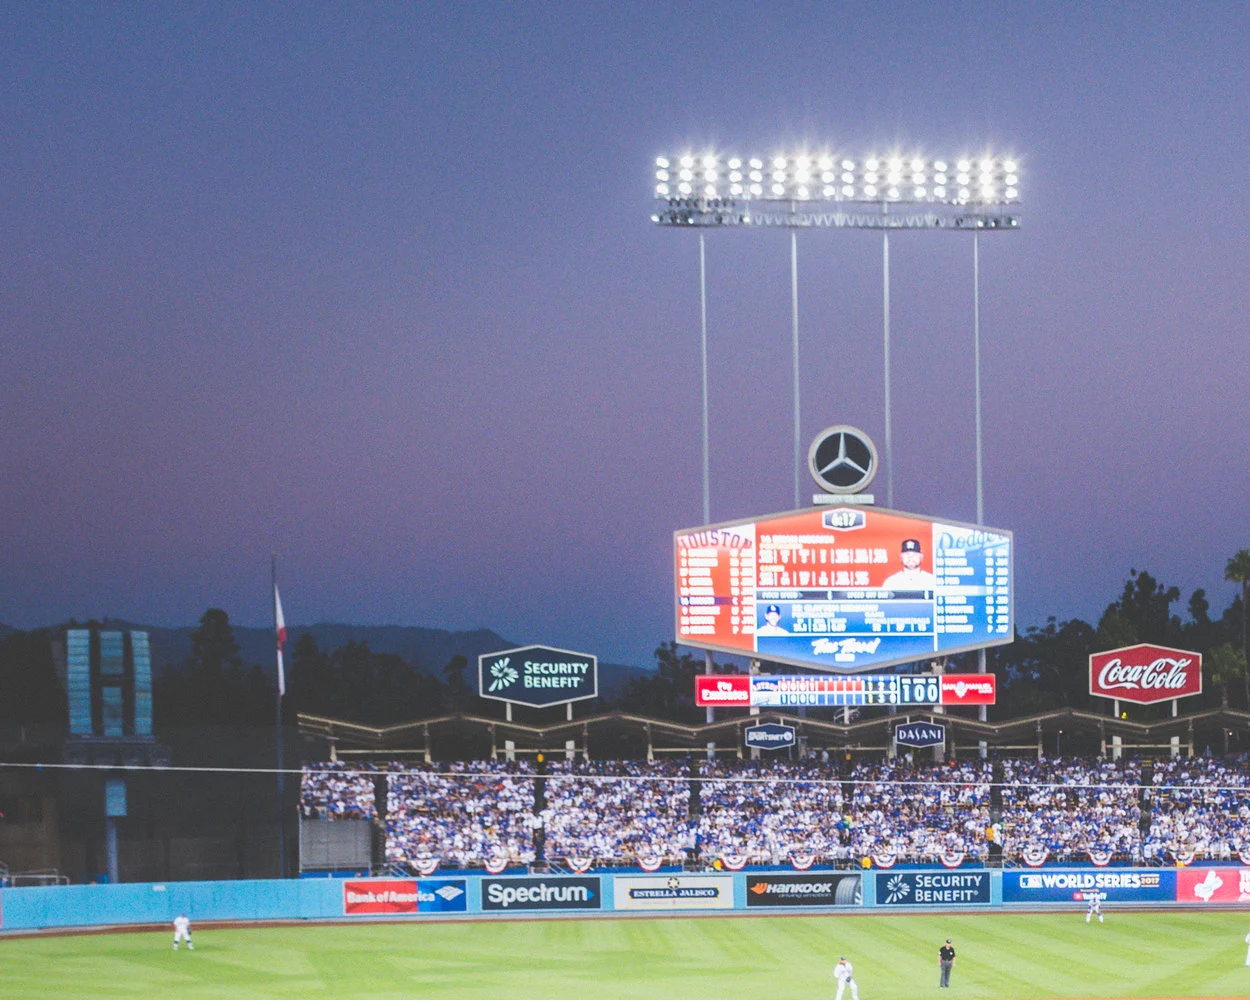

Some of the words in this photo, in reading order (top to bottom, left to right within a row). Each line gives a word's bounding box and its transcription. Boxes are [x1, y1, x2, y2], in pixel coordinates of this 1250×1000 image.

[524, 661, 589, 675] SECURITY
[1098, 657, 1192, 690] Coca-Cola
[899, 729, 941, 742] DASANI
[915, 874, 982, 887] SECURITY
[1042, 874, 1096, 889] WORLD
[1095, 873, 1141, 888] SERIES
[1141, 877, 1160, 885] 2017
[488, 883, 588, 907] Spectrum
[633, 889, 678, 898] ESTRELLA
[679, 888, 715, 897] JALISCO
